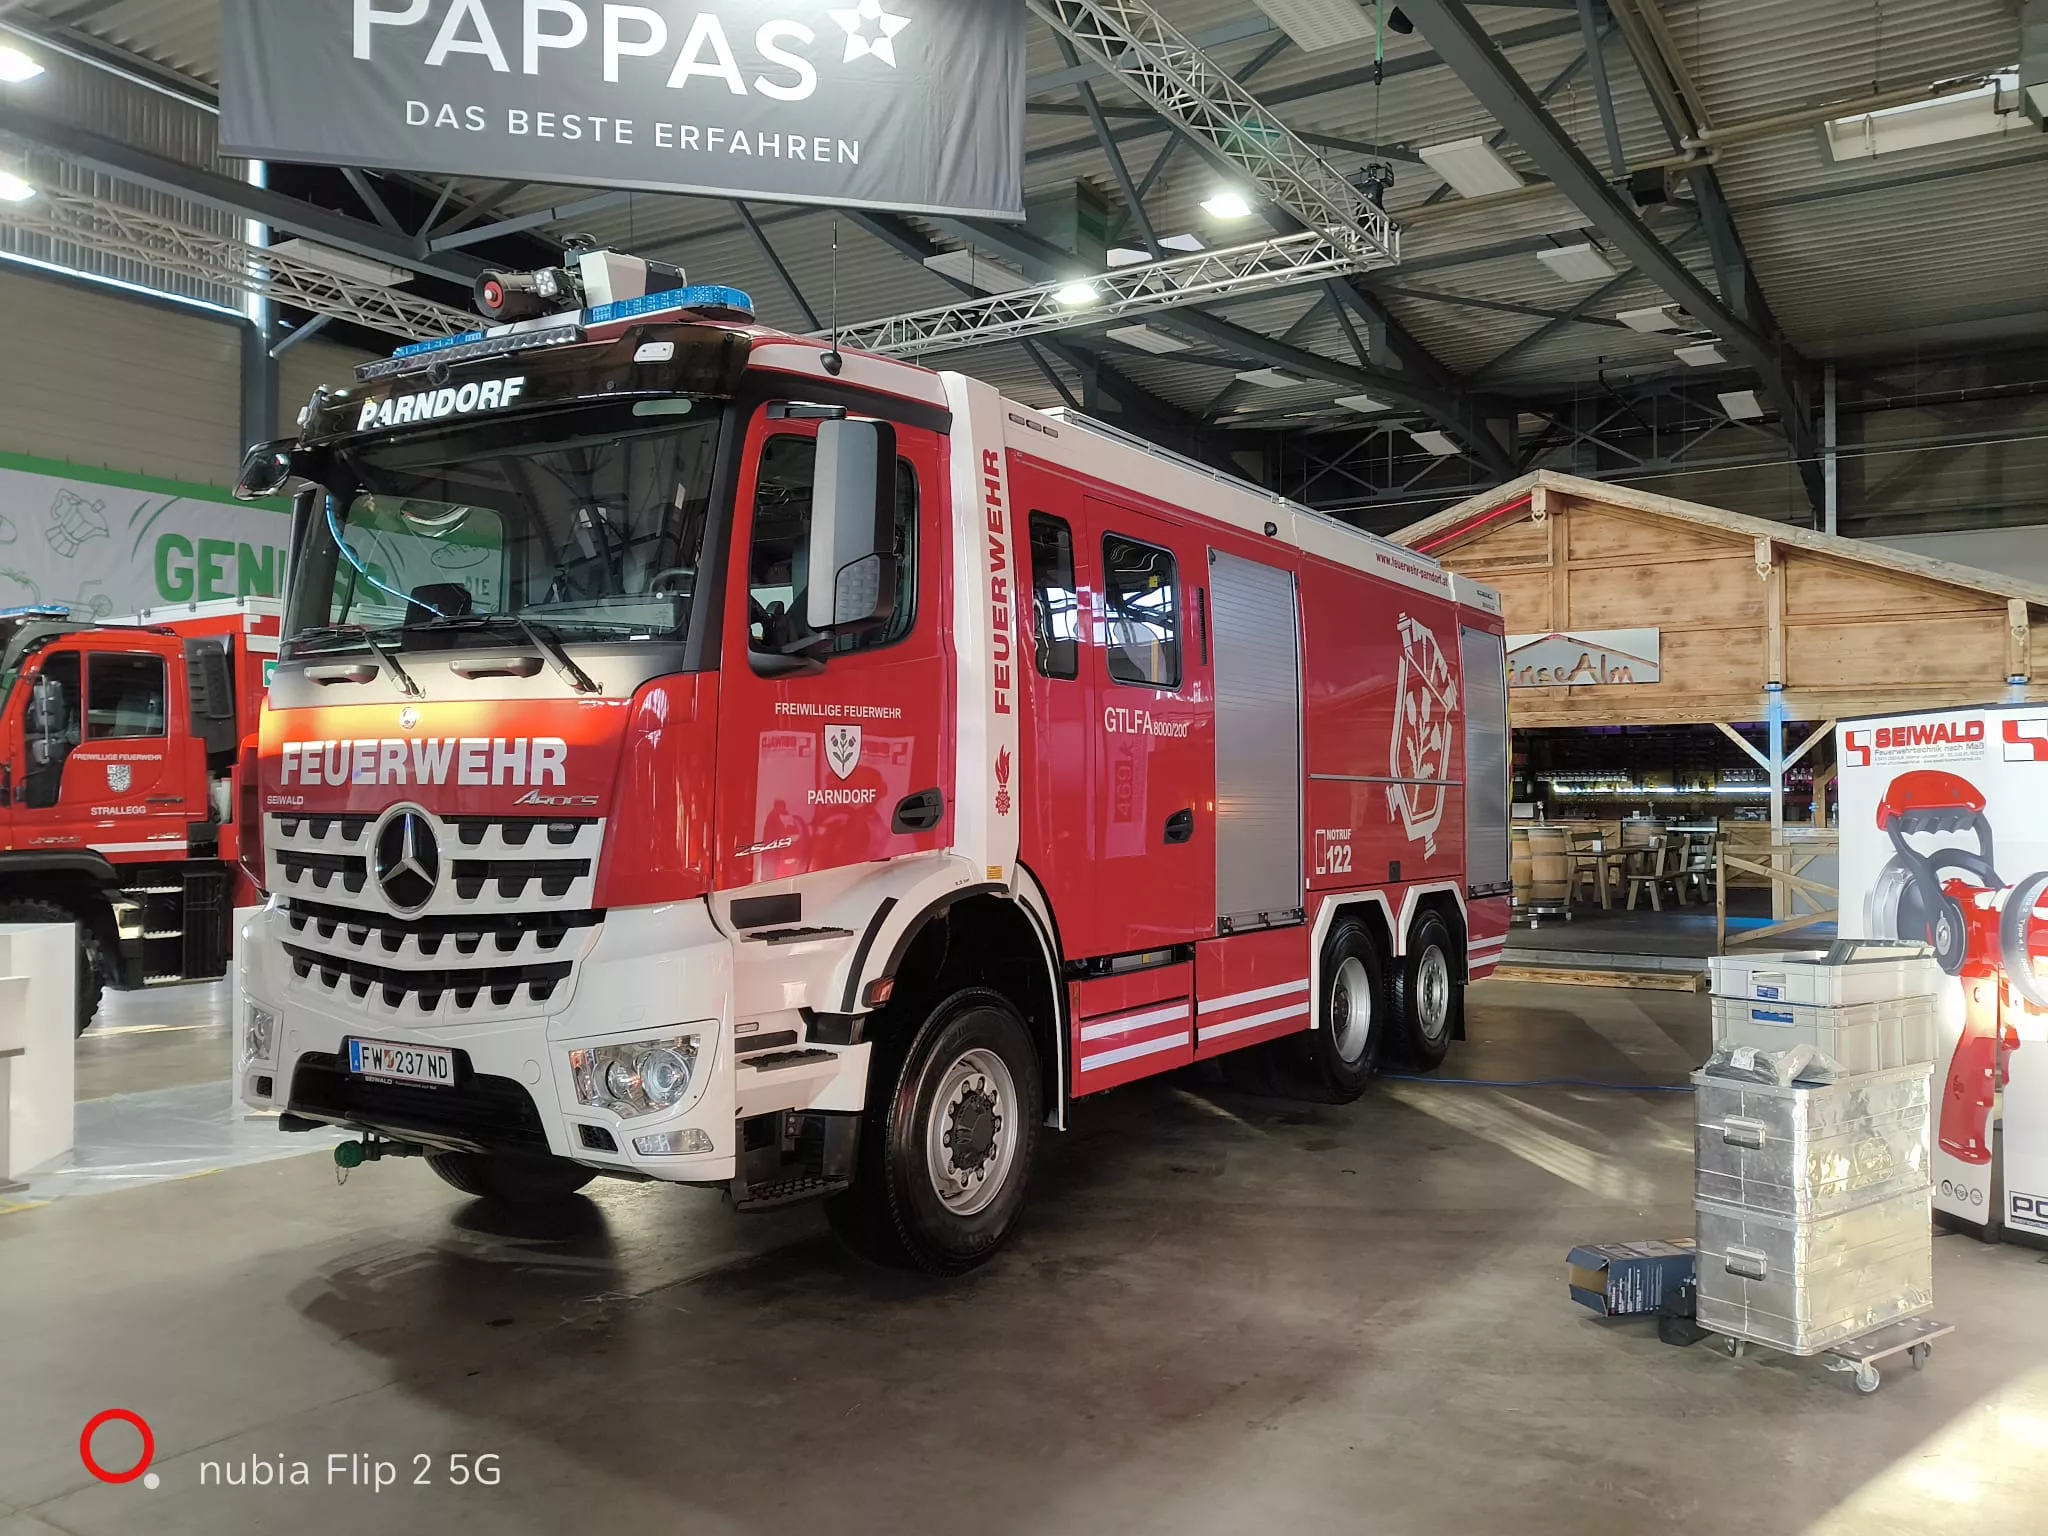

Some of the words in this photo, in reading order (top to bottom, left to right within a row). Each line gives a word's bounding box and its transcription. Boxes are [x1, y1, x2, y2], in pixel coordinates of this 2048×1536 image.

[353, 0, 818, 101] PAPPAS
[406, 100, 486, 132] DAS
[507, 109, 633, 145] BESTE
[654, 122, 861, 165] ERFAHREN
[356, 375, 525, 432] PARNDORF
[983, 448, 1011, 715] FEUERWEHR
[775, 702, 842, 717] FREIWILLIGE
[844, 705, 902, 719] FEUERWEHR
[1104, 706, 1153, 735] GTLFA
[1153, 721, 1188, 738] 8000/200
[1875, 720, 1985, 748] SEIWALD
[72, 753, 118, 761] FREIWILLIGE
[118, 753, 162, 761] FEUERWEHR
[280, 736, 568, 786] FEUERWEHR
[1874, 745, 1942, 756] Feuerwehrtechnik
[1944, 744, 1964, 752] nach
[90, 805, 147, 816] STRALLEGG
[266, 795, 304, 806] SEIWALD
[807, 789, 877, 805] PARNDORF
[1326, 828, 1352, 841] NOTRUF
[1326, 844, 1352, 874] 122
[361, 1046, 382, 1071] FW
[395, 1051, 424, 1076] 237
[427, 1054, 448, 1079] ND
